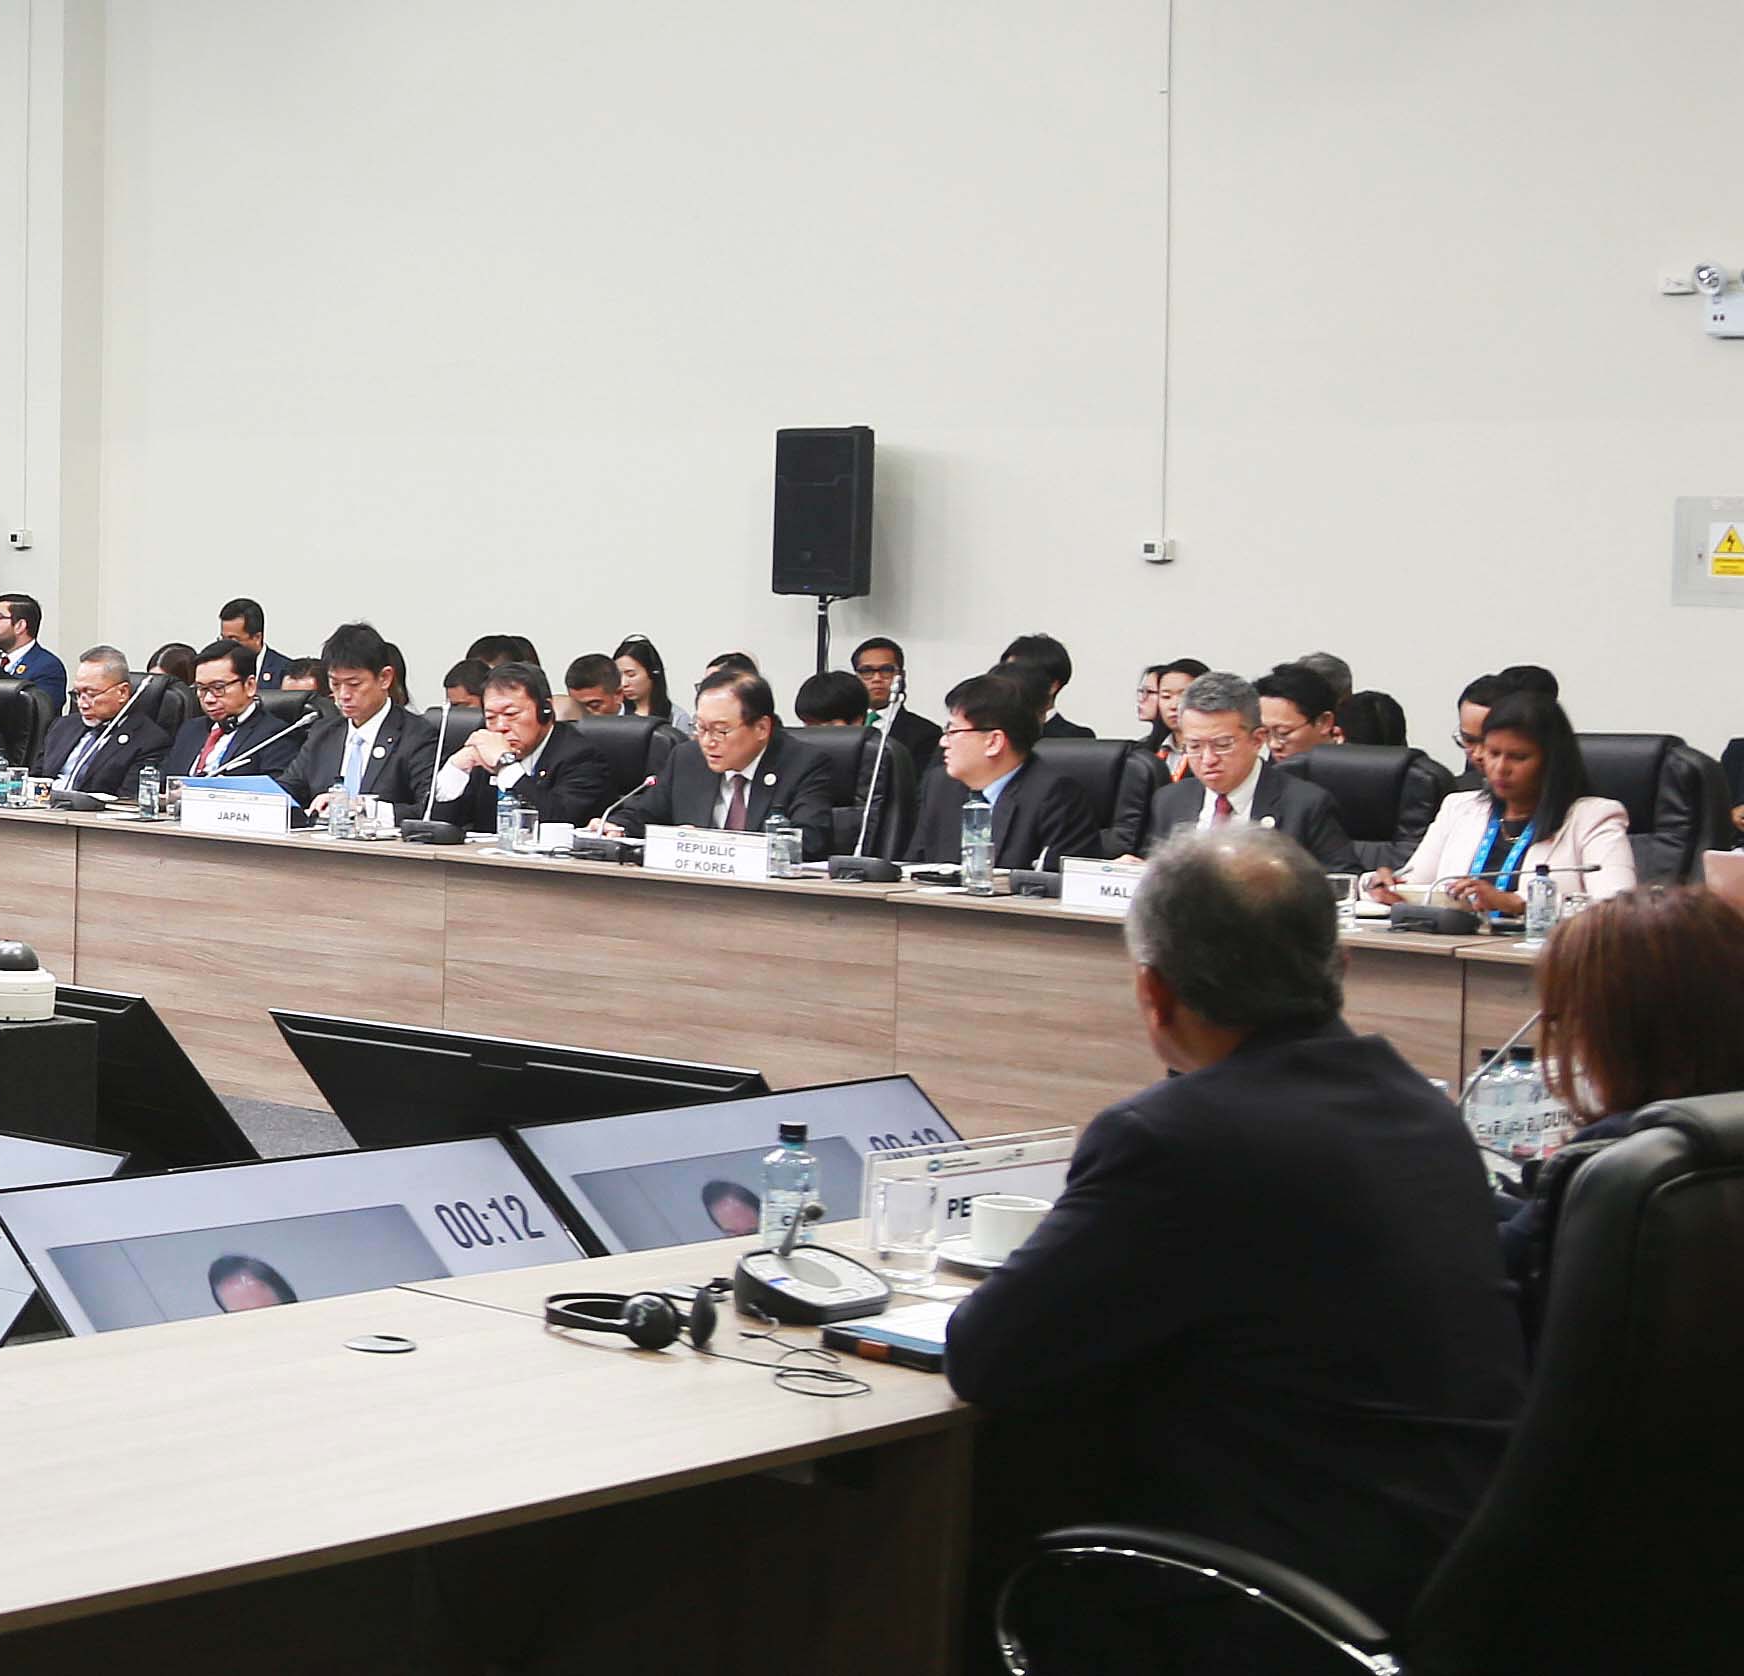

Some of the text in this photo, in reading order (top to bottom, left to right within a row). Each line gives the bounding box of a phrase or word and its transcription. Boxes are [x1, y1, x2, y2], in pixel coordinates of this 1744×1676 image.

[217, 811, 251, 822] JAPAN
[676, 841, 737, 858] REPUBLIC
[674, 858, 736, 875] OF KOREA
[946, 1192, 1001, 1220] PE
[434, 1194, 546, 1249] 00:12
